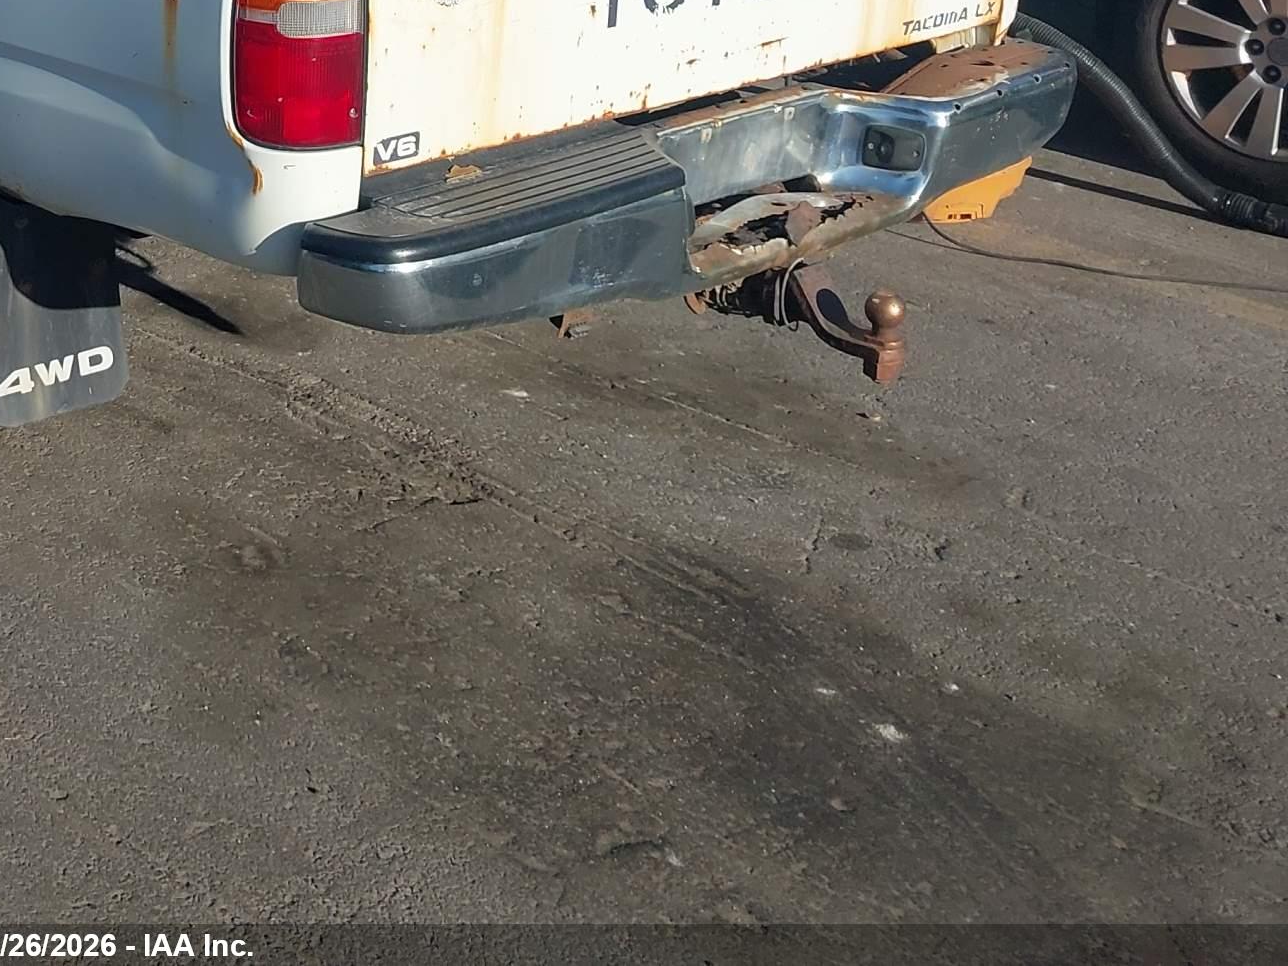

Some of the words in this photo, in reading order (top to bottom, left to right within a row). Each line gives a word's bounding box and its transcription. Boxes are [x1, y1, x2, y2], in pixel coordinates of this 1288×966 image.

[902, 7, 968, 35] TACOMA
[975, 1, 996, 18] LX
[375, 135, 417, 161] V6
